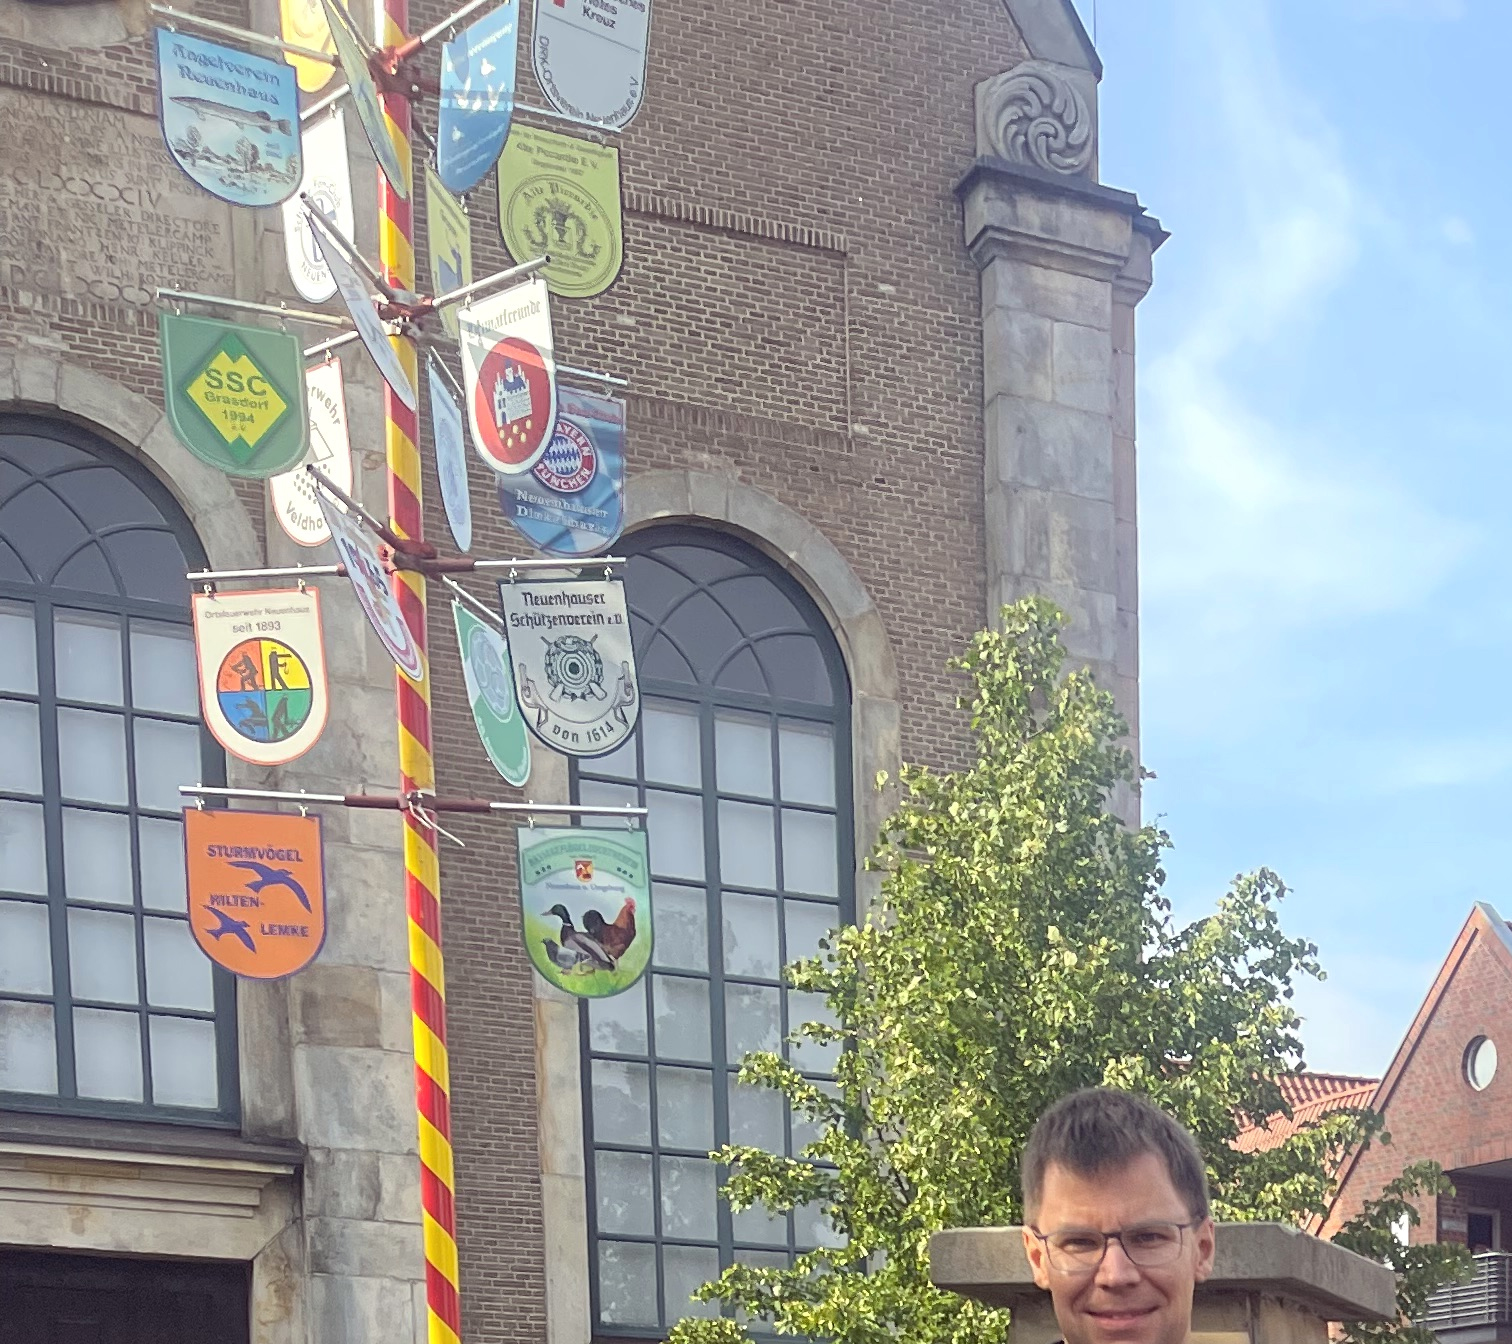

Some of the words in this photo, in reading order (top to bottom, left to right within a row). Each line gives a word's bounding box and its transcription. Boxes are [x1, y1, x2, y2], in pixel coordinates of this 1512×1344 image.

[204, 367, 268, 397] SSC
[203, 390, 269, 411] Grasdorf
[232, 621, 253, 634] seit
[256, 620, 281, 632] 1893
[509, 610, 605, 630] Schützenverein
[552, 724, 580, 744] von
[587, 720, 615, 744] 1614
[206, 843, 303, 863] STURMVÖGEL
[260, 921, 310, 938] LEMKE
